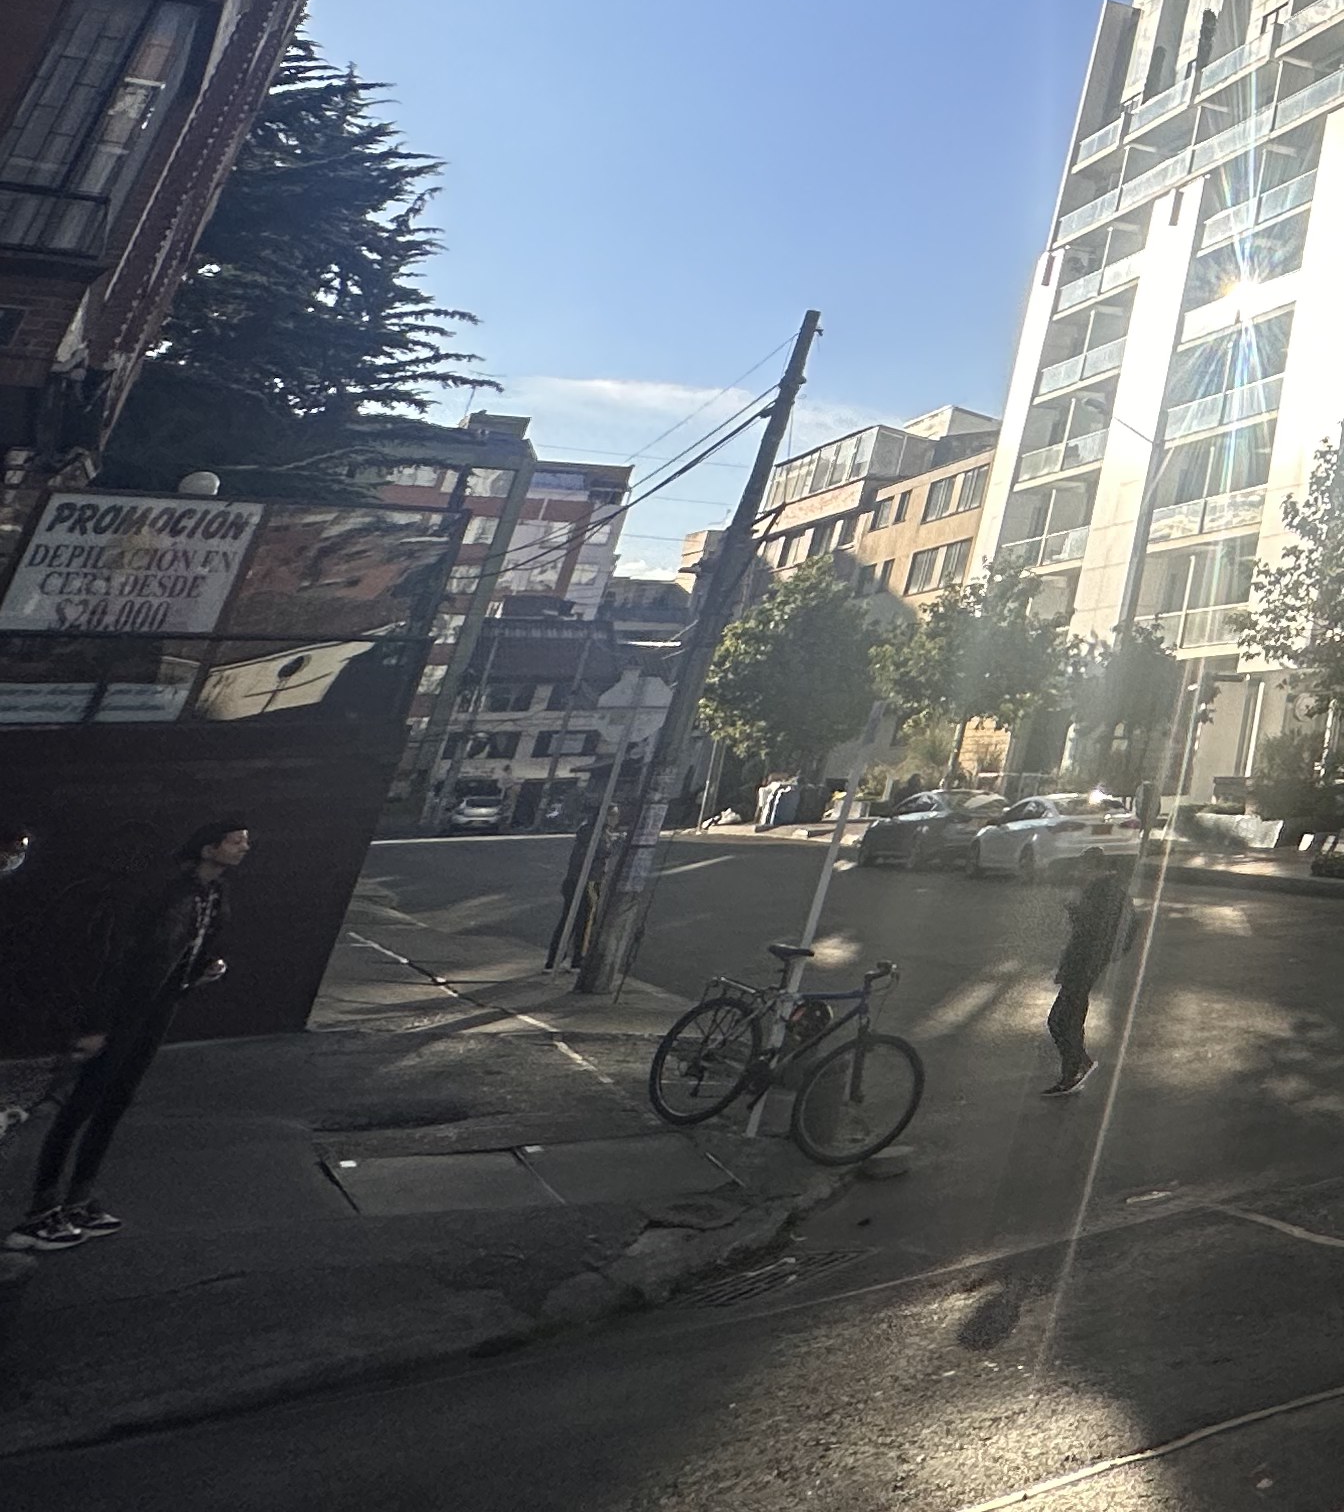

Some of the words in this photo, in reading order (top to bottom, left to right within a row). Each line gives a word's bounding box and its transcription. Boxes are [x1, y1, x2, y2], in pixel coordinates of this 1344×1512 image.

[46, 500, 250, 541] PROMOCIÓN
[117, 574, 207, 599] DESDE
[54, 600, 171, 631] $20.000
